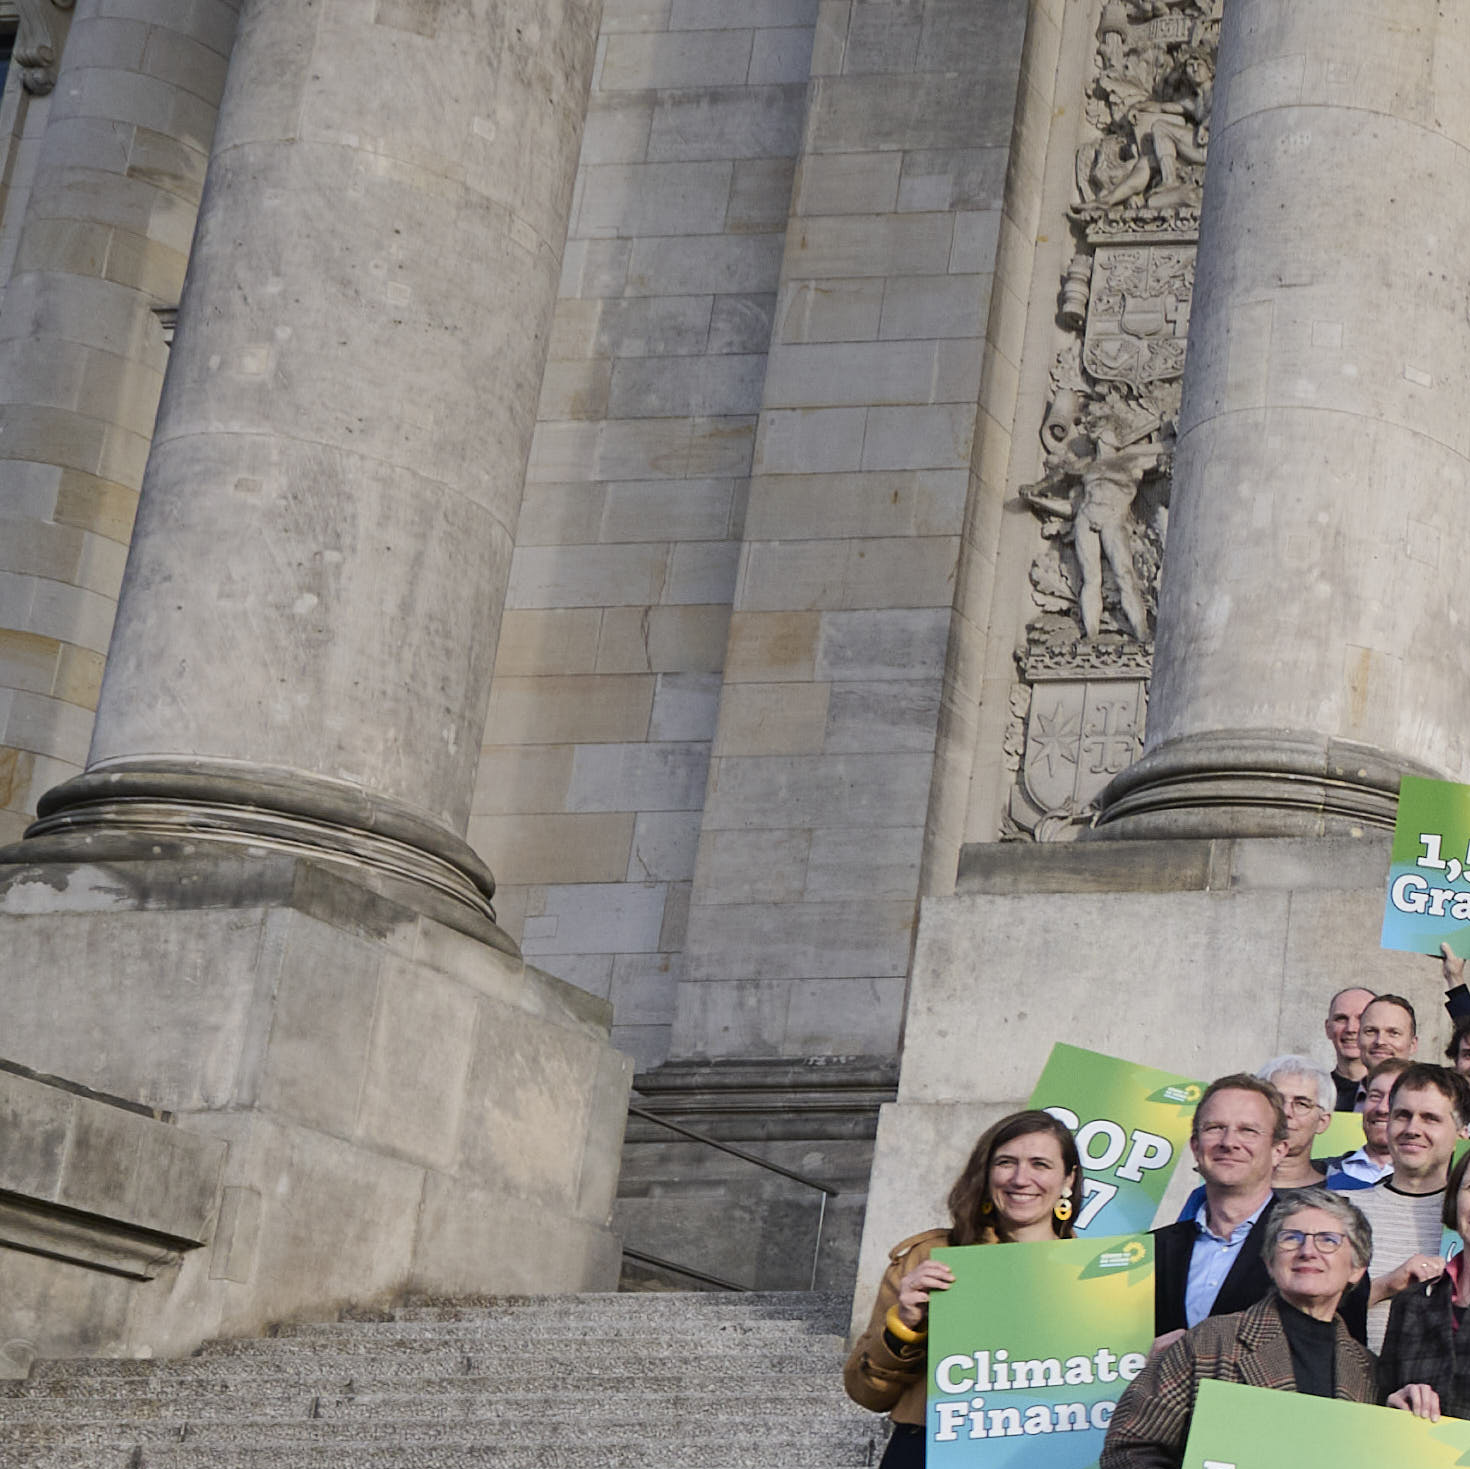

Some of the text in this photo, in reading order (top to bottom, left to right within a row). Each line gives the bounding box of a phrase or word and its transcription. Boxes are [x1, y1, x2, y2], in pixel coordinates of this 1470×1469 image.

[1074, 1177, 1119, 1230] 7
[935, 1347, 1148, 1395] Climate
[934, 1397, 1118, 1442] Financ
